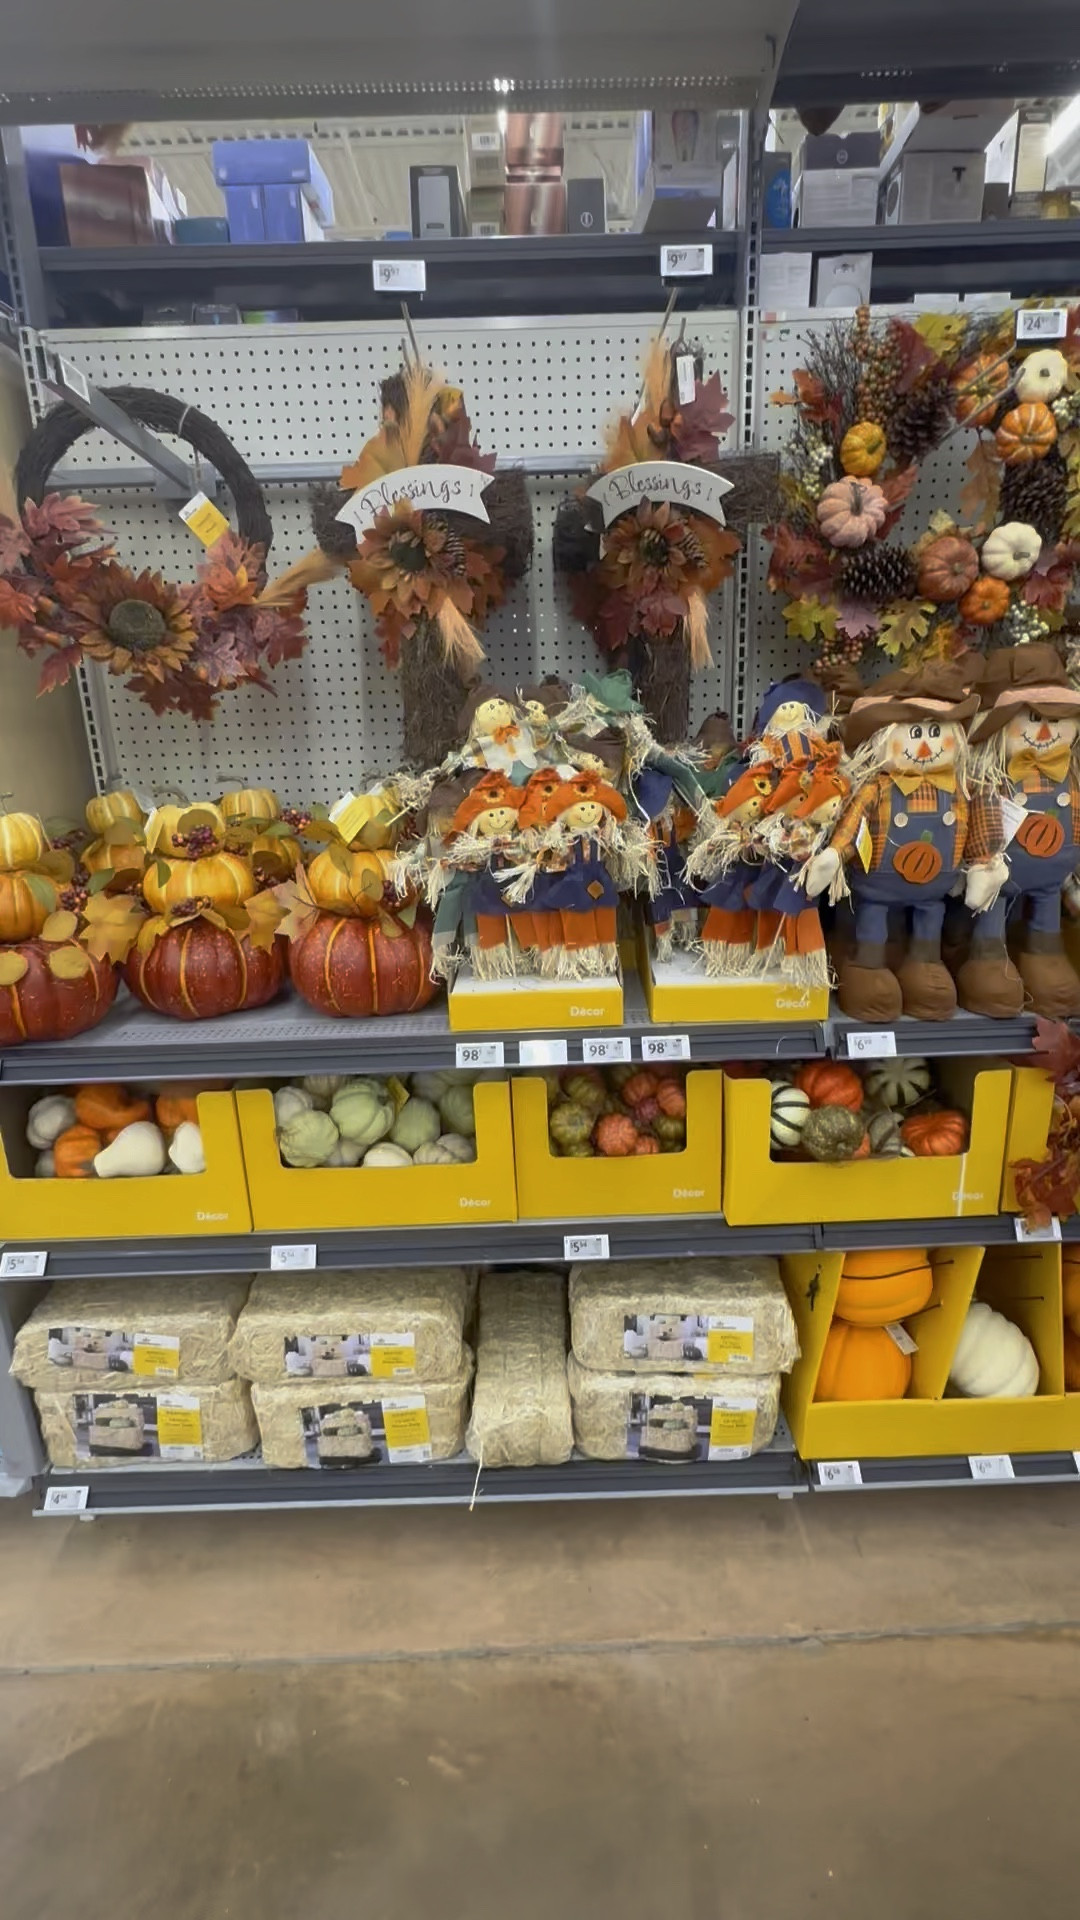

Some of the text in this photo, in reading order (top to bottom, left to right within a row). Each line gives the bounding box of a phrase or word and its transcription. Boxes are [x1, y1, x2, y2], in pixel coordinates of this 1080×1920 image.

[360, 479, 462, 516] Blessings
[609, 471, 702, 500] Blessings
[570, 1005, 605, 1017] Décor
